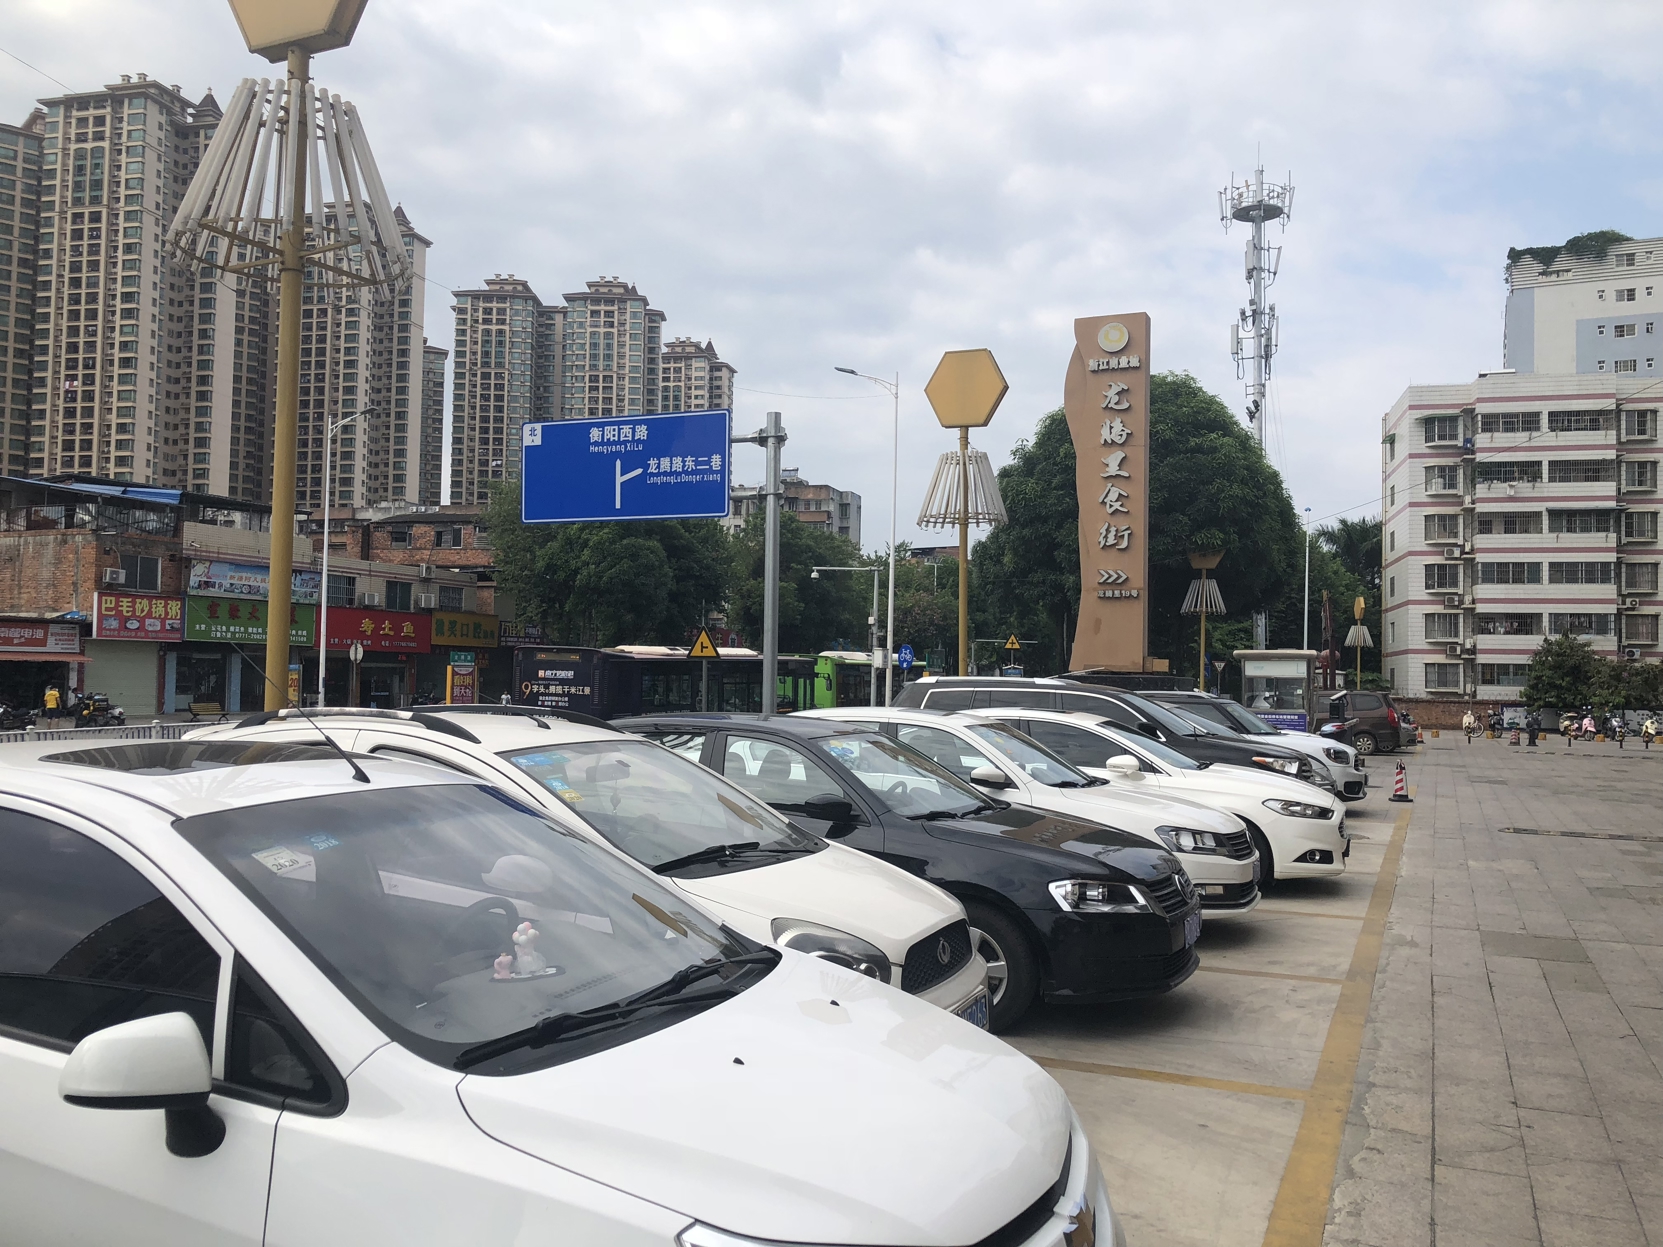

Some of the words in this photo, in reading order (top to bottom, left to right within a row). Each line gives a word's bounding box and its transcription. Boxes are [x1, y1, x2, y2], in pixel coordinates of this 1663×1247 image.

[1088, 354, 1140, 371] 浙江商业城
[528, 426, 538, 438] 北
[589, 424, 649, 443] 衡阳西路
[589, 444, 625, 454] Hengyang
[647, 453, 722, 474] 龙腾路东二巷
[101, 596, 181, 619] 巴毛砂锅粥
[453, 675, 473, 686] 看妇科
[313, 838, 339, 850] 2018
[271, 858, 300, 871] 2020
